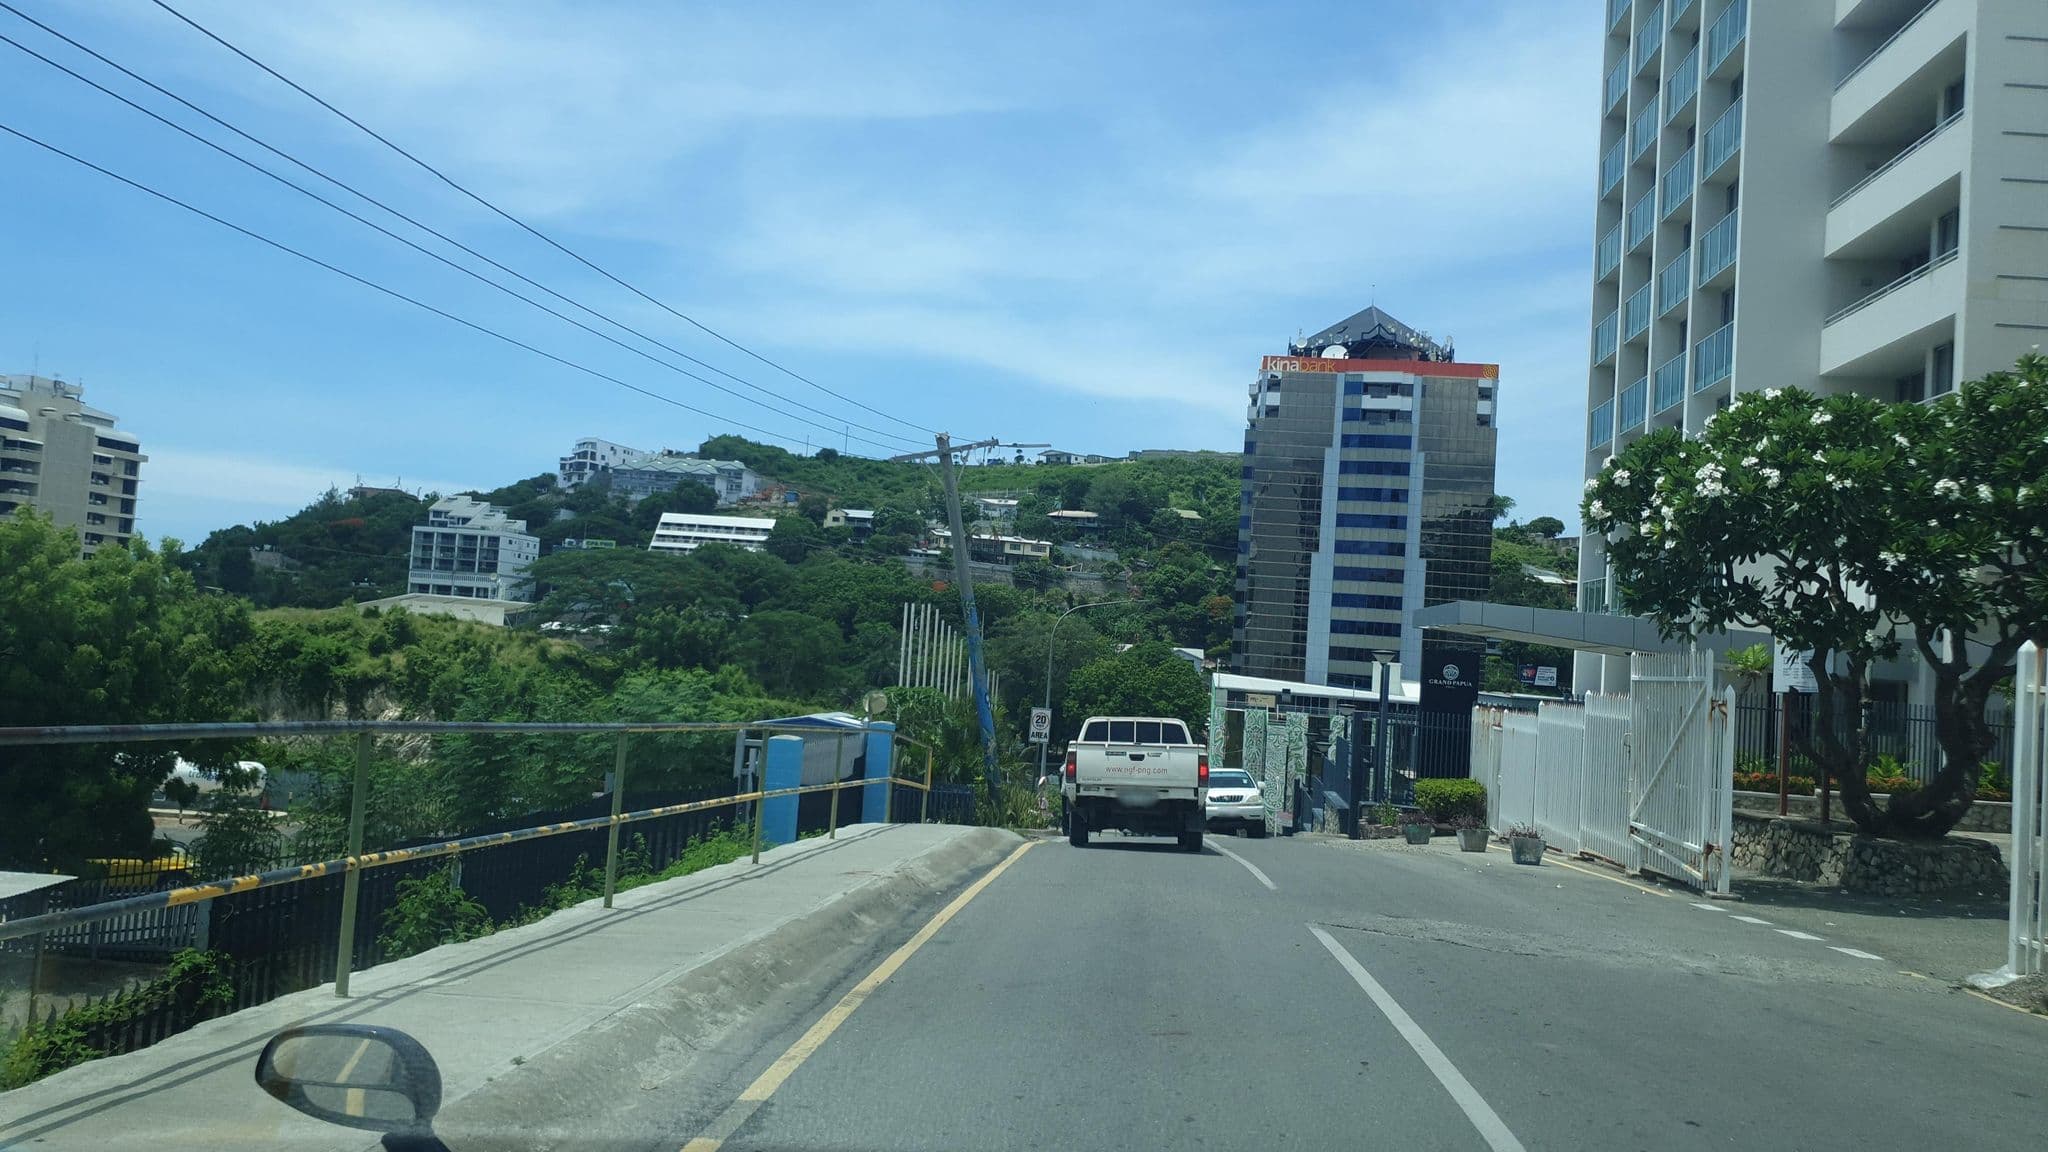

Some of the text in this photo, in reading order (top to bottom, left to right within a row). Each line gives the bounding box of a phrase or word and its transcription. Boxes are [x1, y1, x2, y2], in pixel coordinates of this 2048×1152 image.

[1428, 678, 1452, 686] GRAND
[1035, 714, 1047, 724] 20
[1030, 731, 1048, 739] AREA
